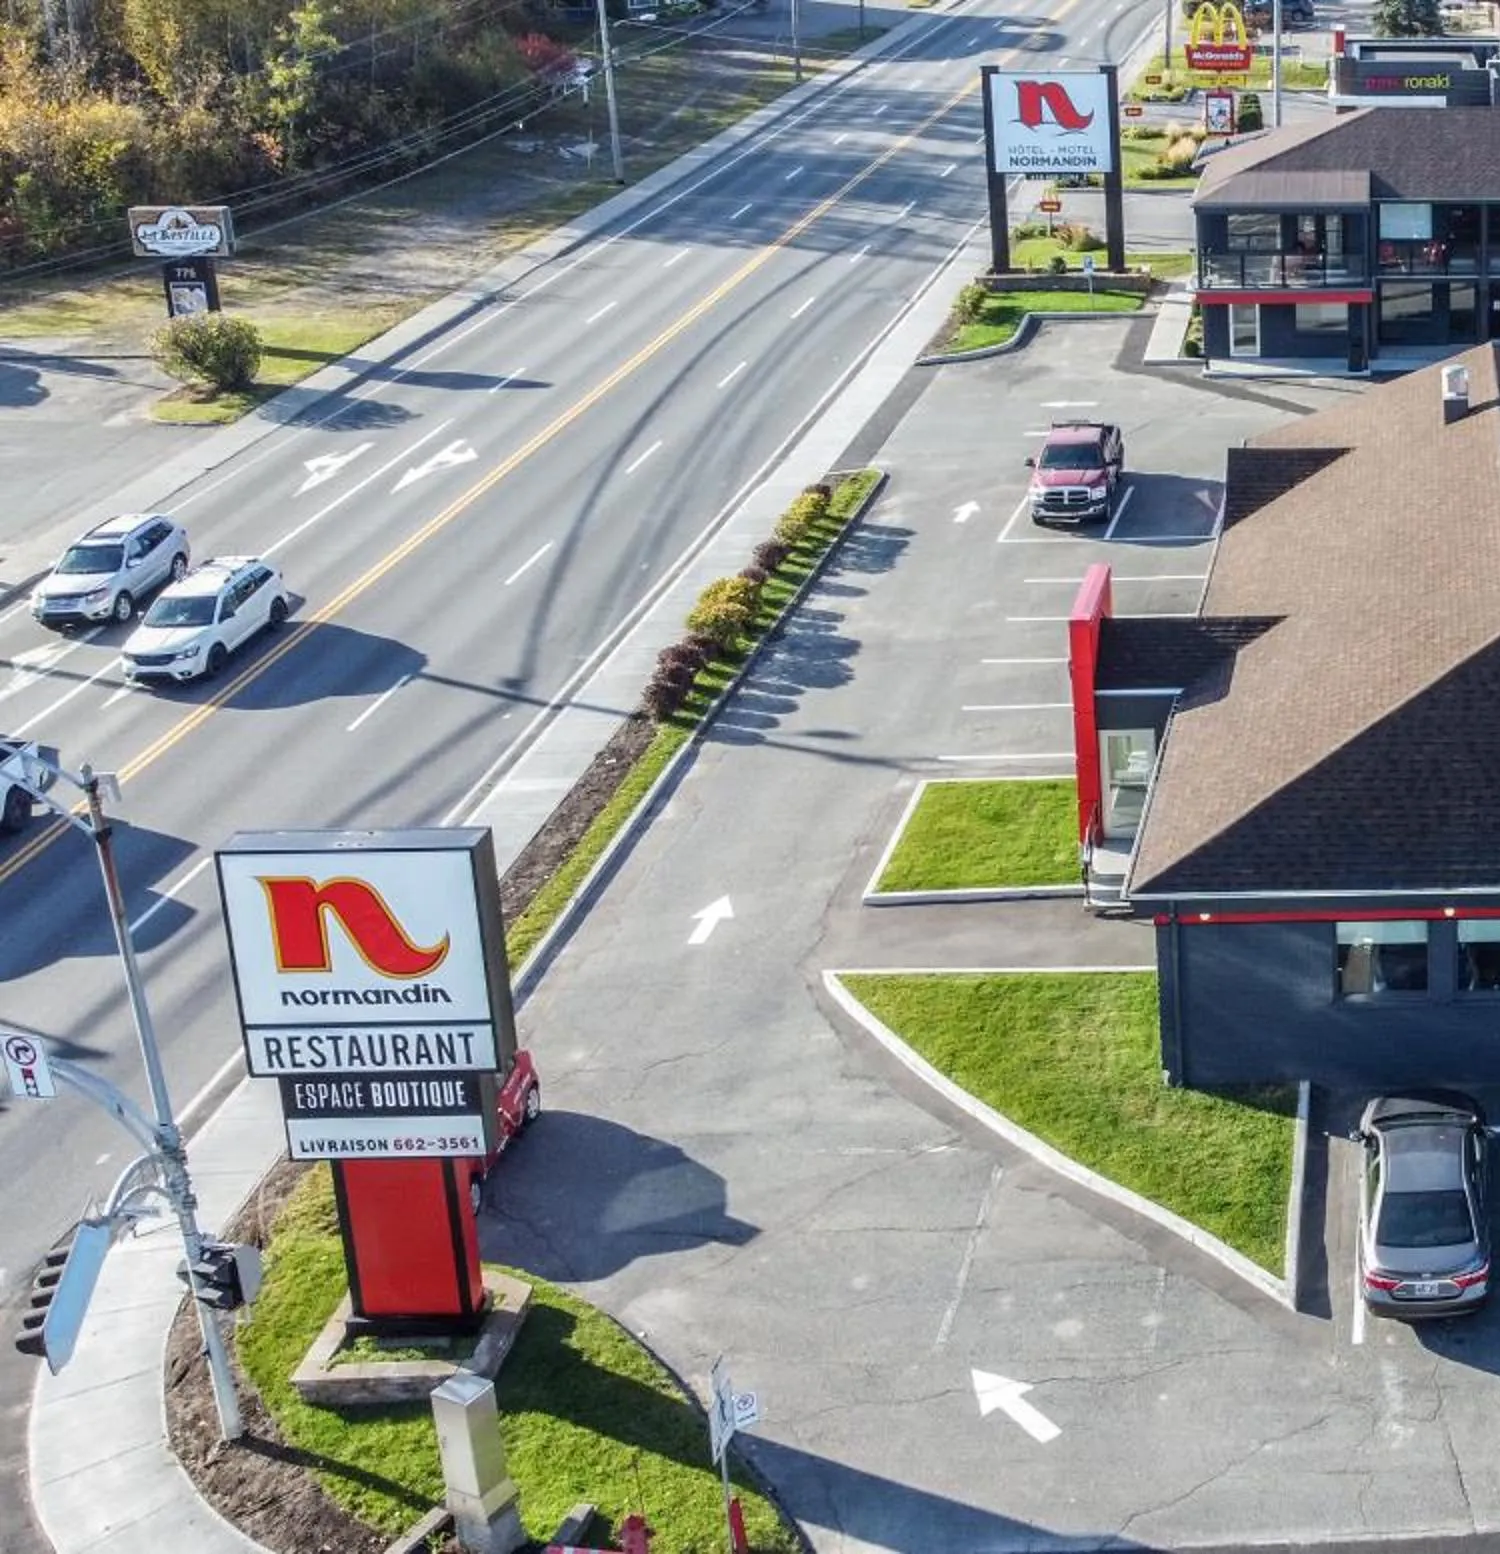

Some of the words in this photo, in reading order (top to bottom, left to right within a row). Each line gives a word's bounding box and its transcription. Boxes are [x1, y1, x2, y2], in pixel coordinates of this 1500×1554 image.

[1404, 73, 1450, 90] ronald
[1008, 156, 1097, 167] NORMANDIN
[281, 984, 452, 1006] normandin
[263, 1032, 474, 1068] RESTAURANT
[295, 1082, 366, 1108] ESPACE
[371, 1080, 467, 1107] BOUTIQUE
[300, 1138, 389, 1152] LIVRAISON
[392, 1136, 479, 1150] 662-3561
